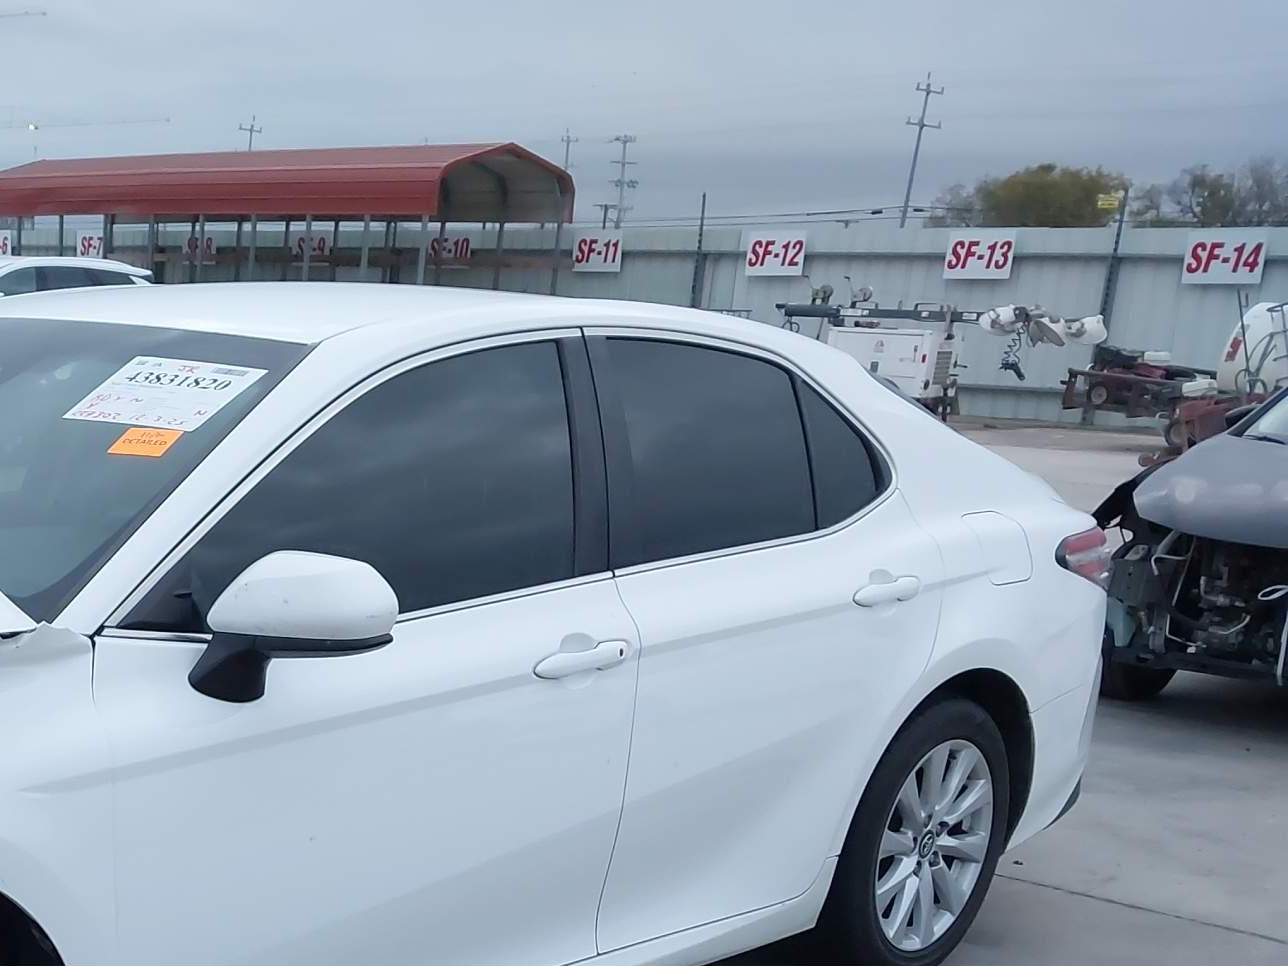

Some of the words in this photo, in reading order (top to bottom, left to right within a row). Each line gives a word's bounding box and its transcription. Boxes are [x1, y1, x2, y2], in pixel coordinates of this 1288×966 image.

[80, 236, 104, 256] SF-7
[575, 238, 620, 264] SF-11
[748, 239, 804, 267] SF-12
[946, 240, 1013, 269] SF-13
[1186, 241, 1264, 274] SF-14
[126, 371, 232, 391] 43831820
